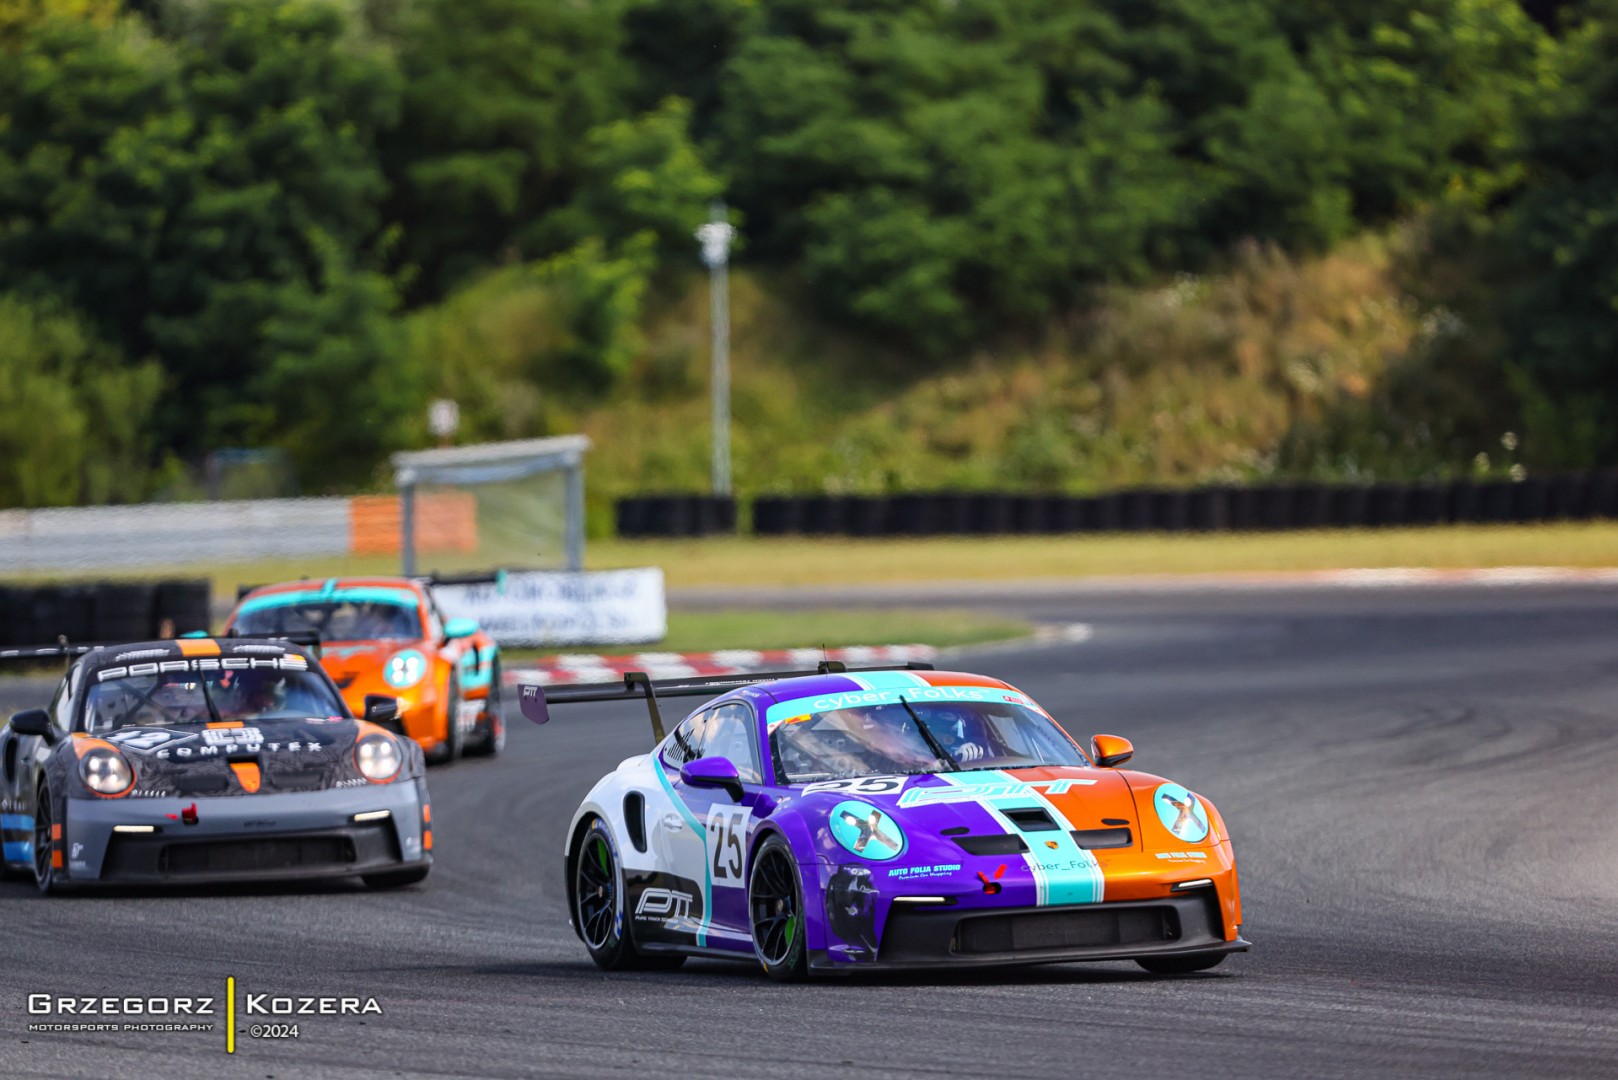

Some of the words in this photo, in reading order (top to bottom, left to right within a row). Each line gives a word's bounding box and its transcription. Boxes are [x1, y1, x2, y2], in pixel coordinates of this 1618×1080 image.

[98, 658, 308, 681] PORSCHE
[710, 812, 743, 879] 25
[888, 868, 908, 877] AUTO
[910, 865, 932, 874] FOLIA
[933, 864, 961, 872] STUDIO
